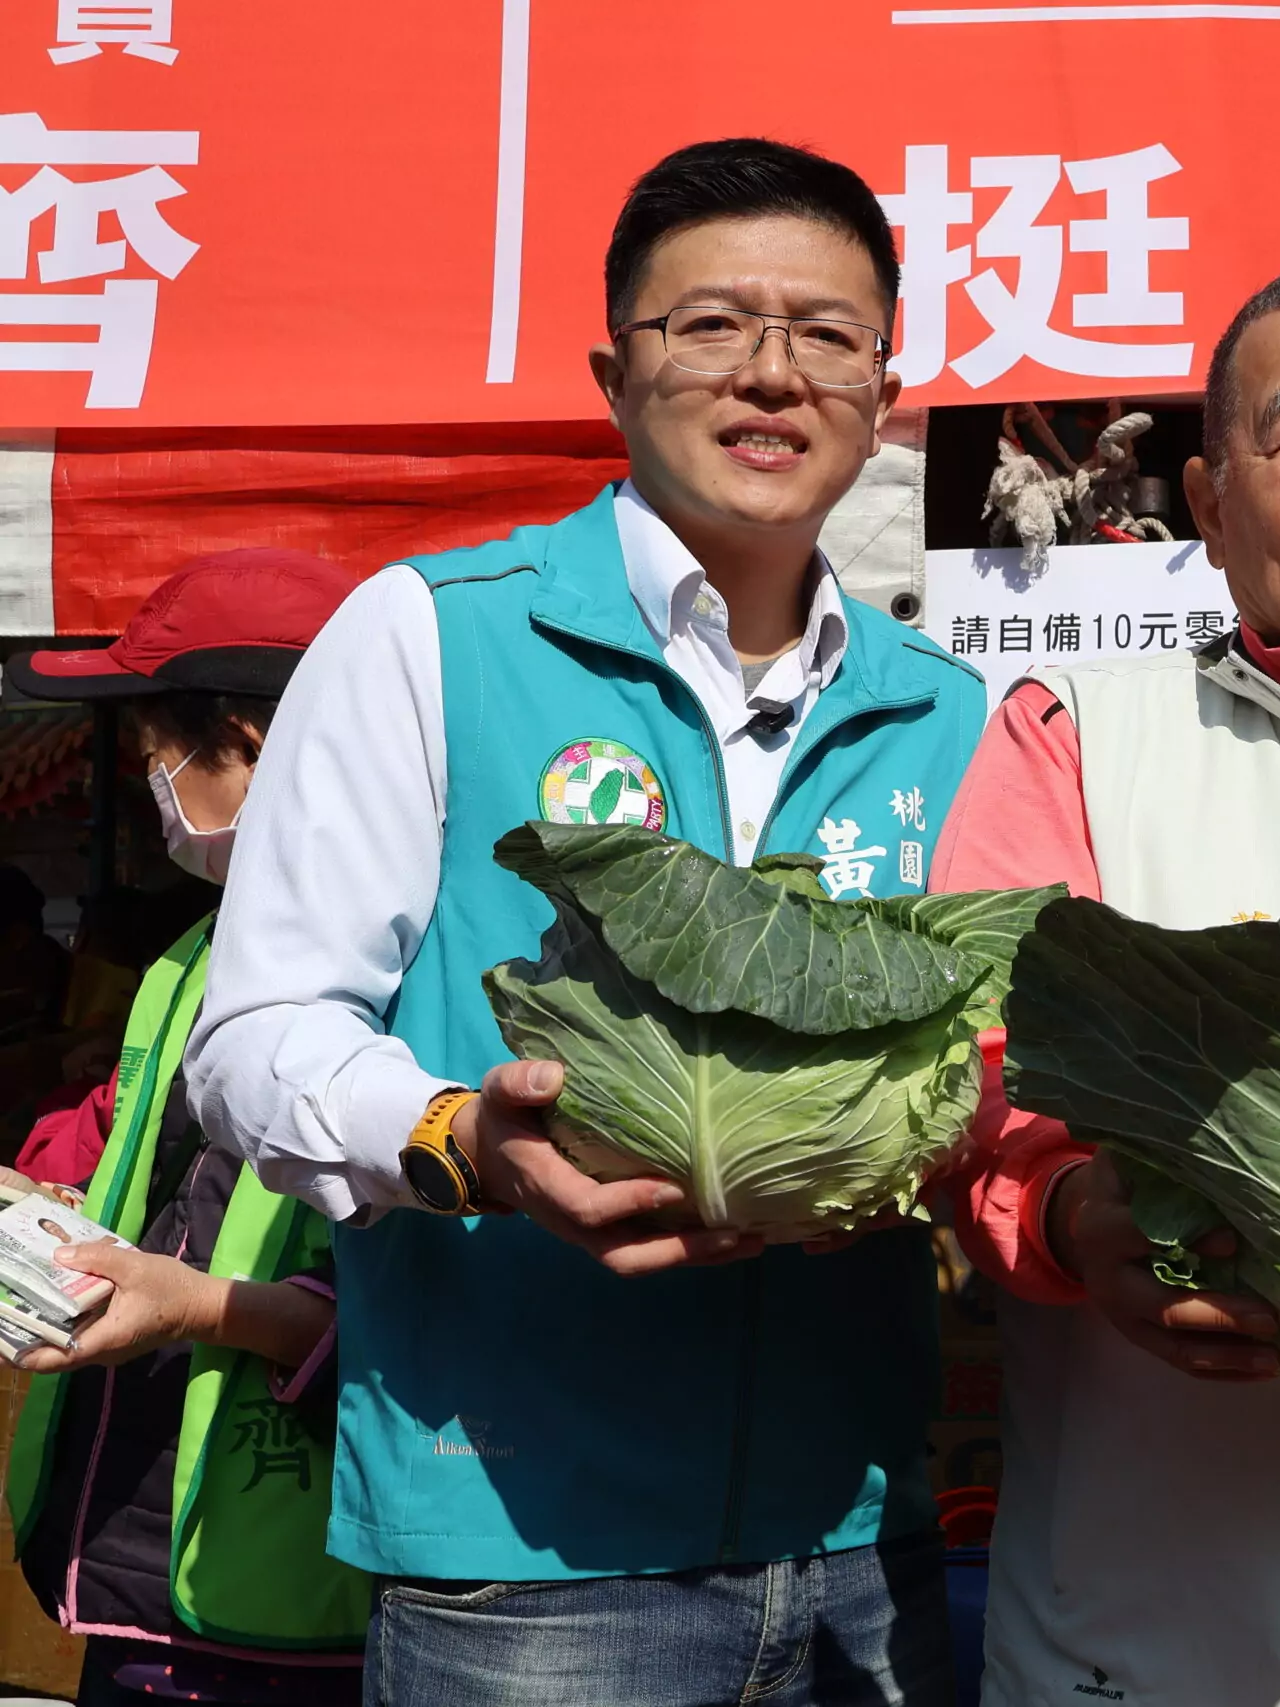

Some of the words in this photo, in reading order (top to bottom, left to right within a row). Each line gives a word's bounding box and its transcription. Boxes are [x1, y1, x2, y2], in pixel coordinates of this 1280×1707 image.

[951, 609, 1240, 655] 請自備10元零
[888, 786, 926, 888] 桃園
